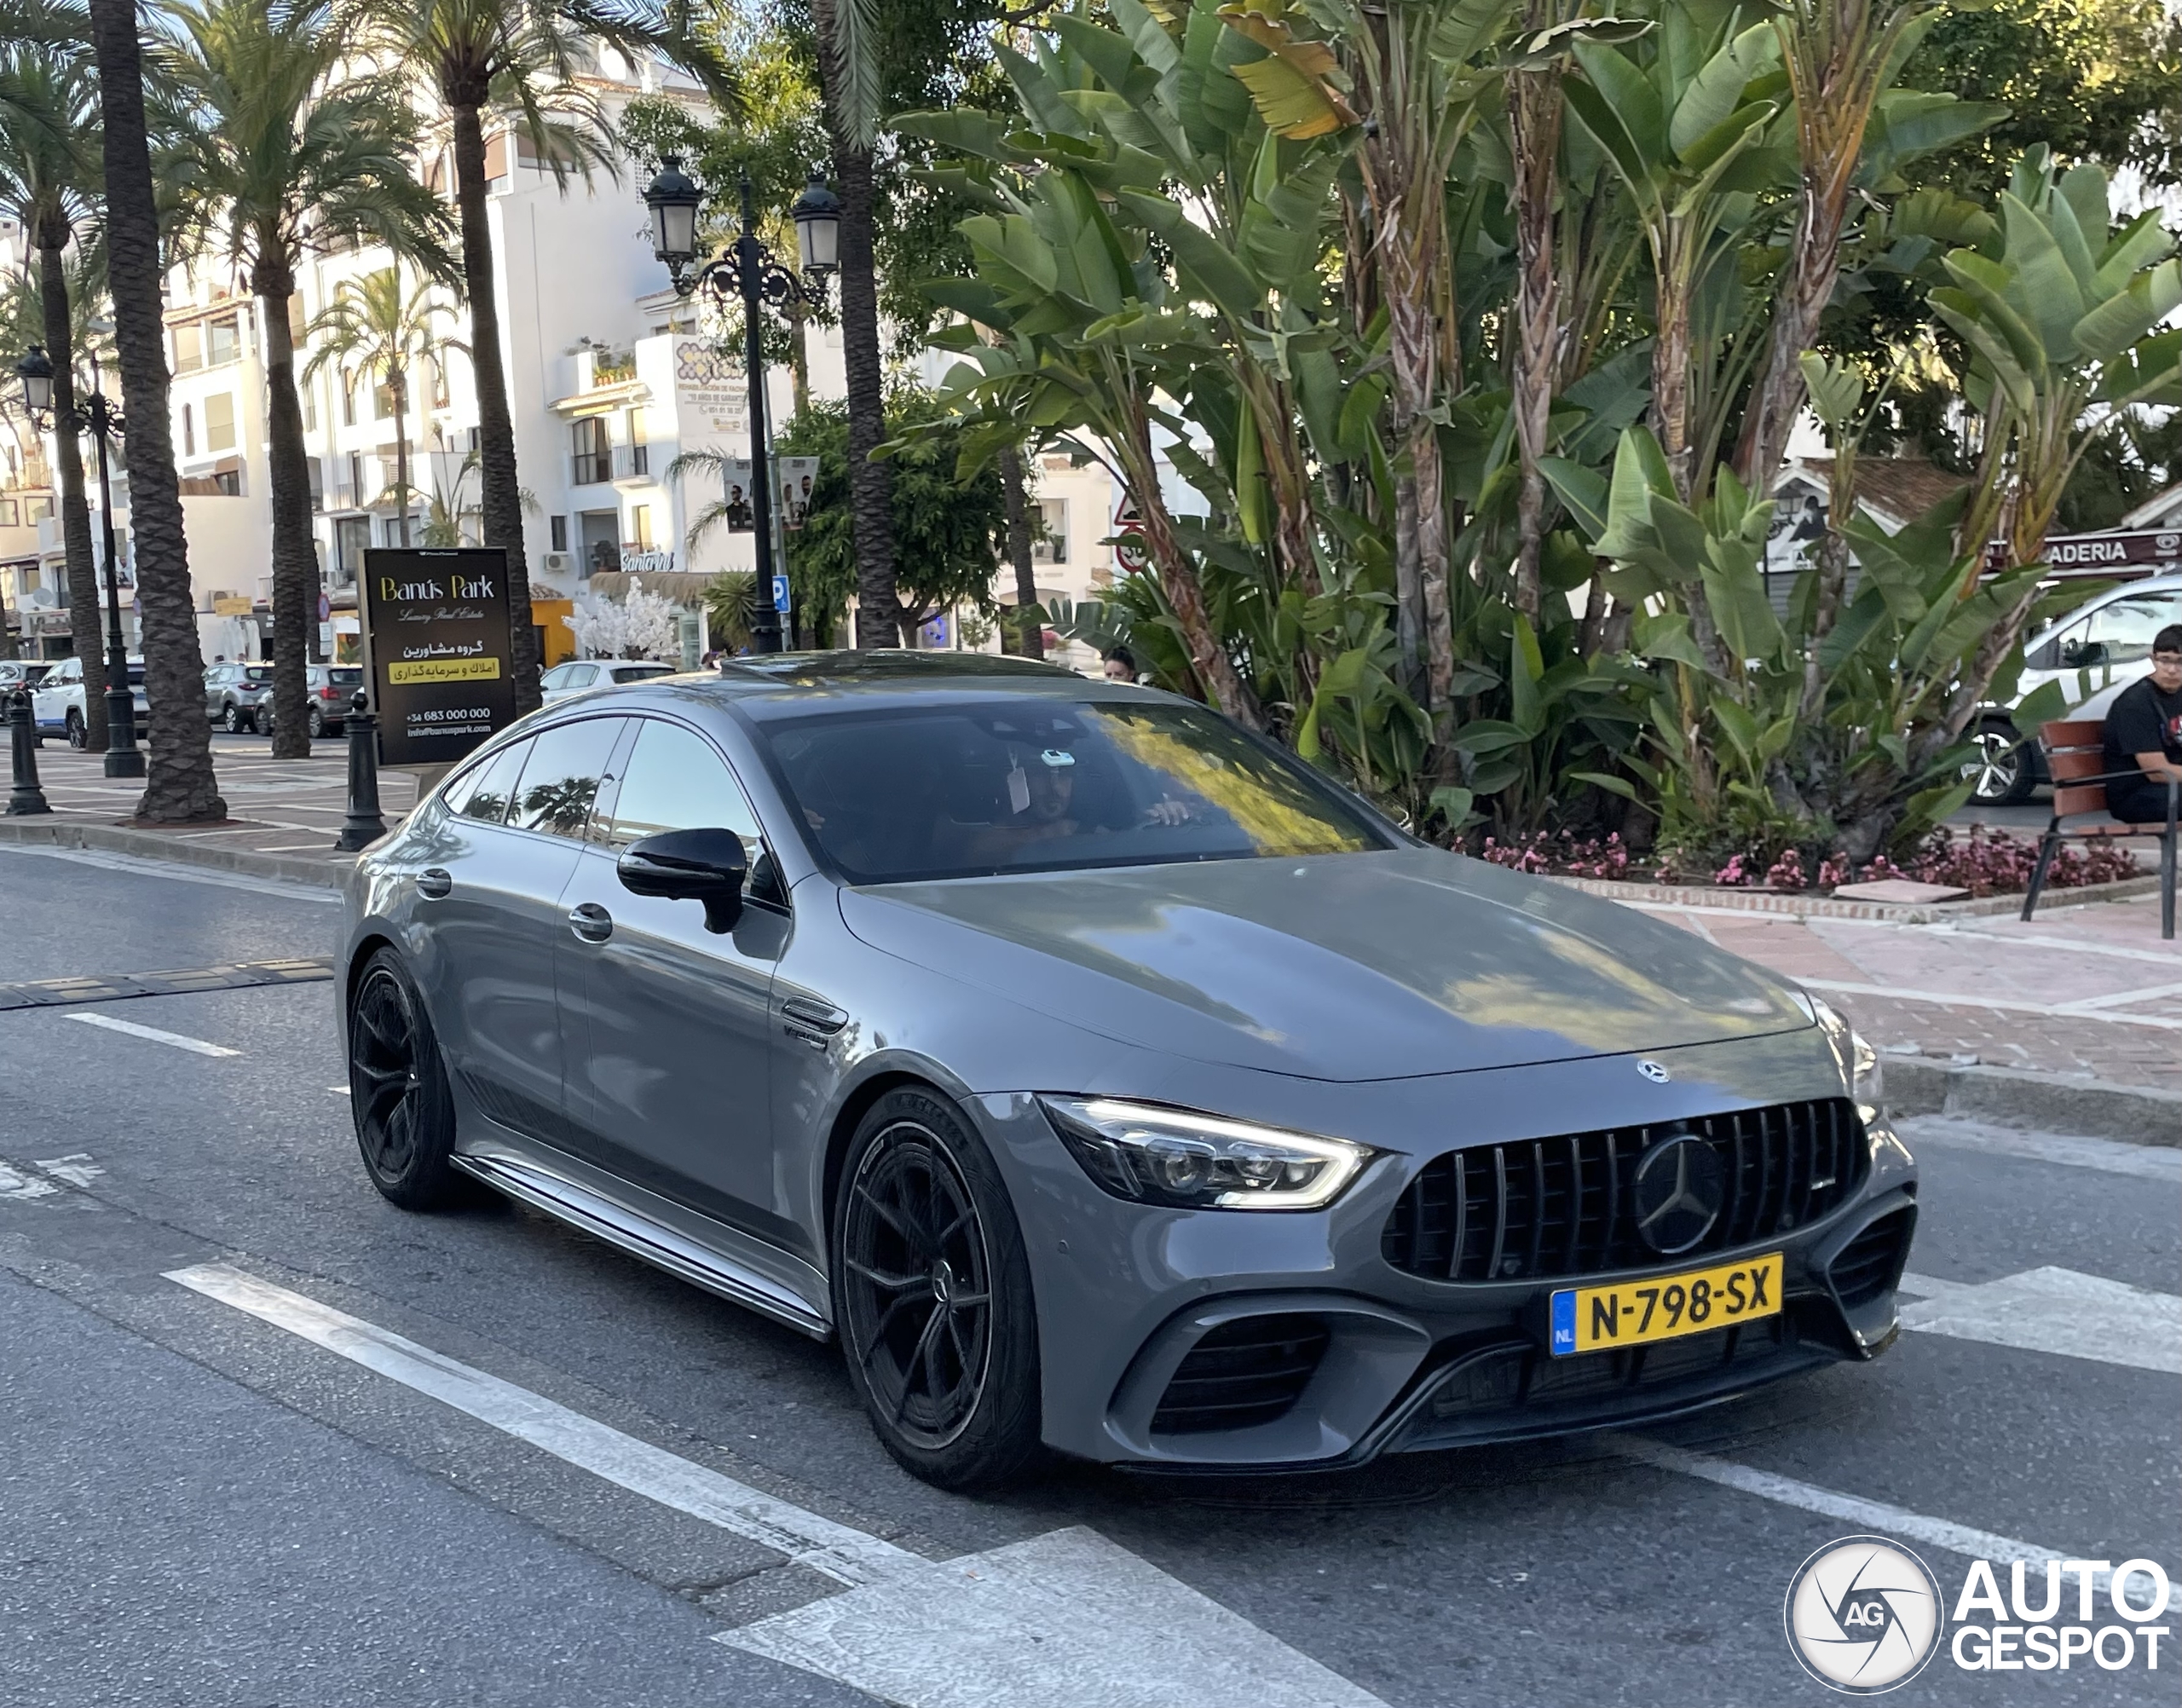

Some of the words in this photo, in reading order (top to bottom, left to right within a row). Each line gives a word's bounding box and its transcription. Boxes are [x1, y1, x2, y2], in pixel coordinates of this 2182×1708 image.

[2045, 542, 2127, 563] ADERIA
[380, 577, 443, 601] Banús
[451, 574, 494, 599] Park
[773, 580, 784, 606] P
[433, 607, 460, 620] Real
[403, 642, 455, 659] مشاورین
[458, 640, 483, 656] گروه
[462, 667, 467, 677] و
[407, 713, 422, 723] +34
[424, 711, 444, 721] 683
[447, 709, 467, 720] 000
[470, 708, 490, 718] 000
[1592, 1266, 1770, 1340] N-798-SX
[1556, 1329, 1573, 1344] NL
